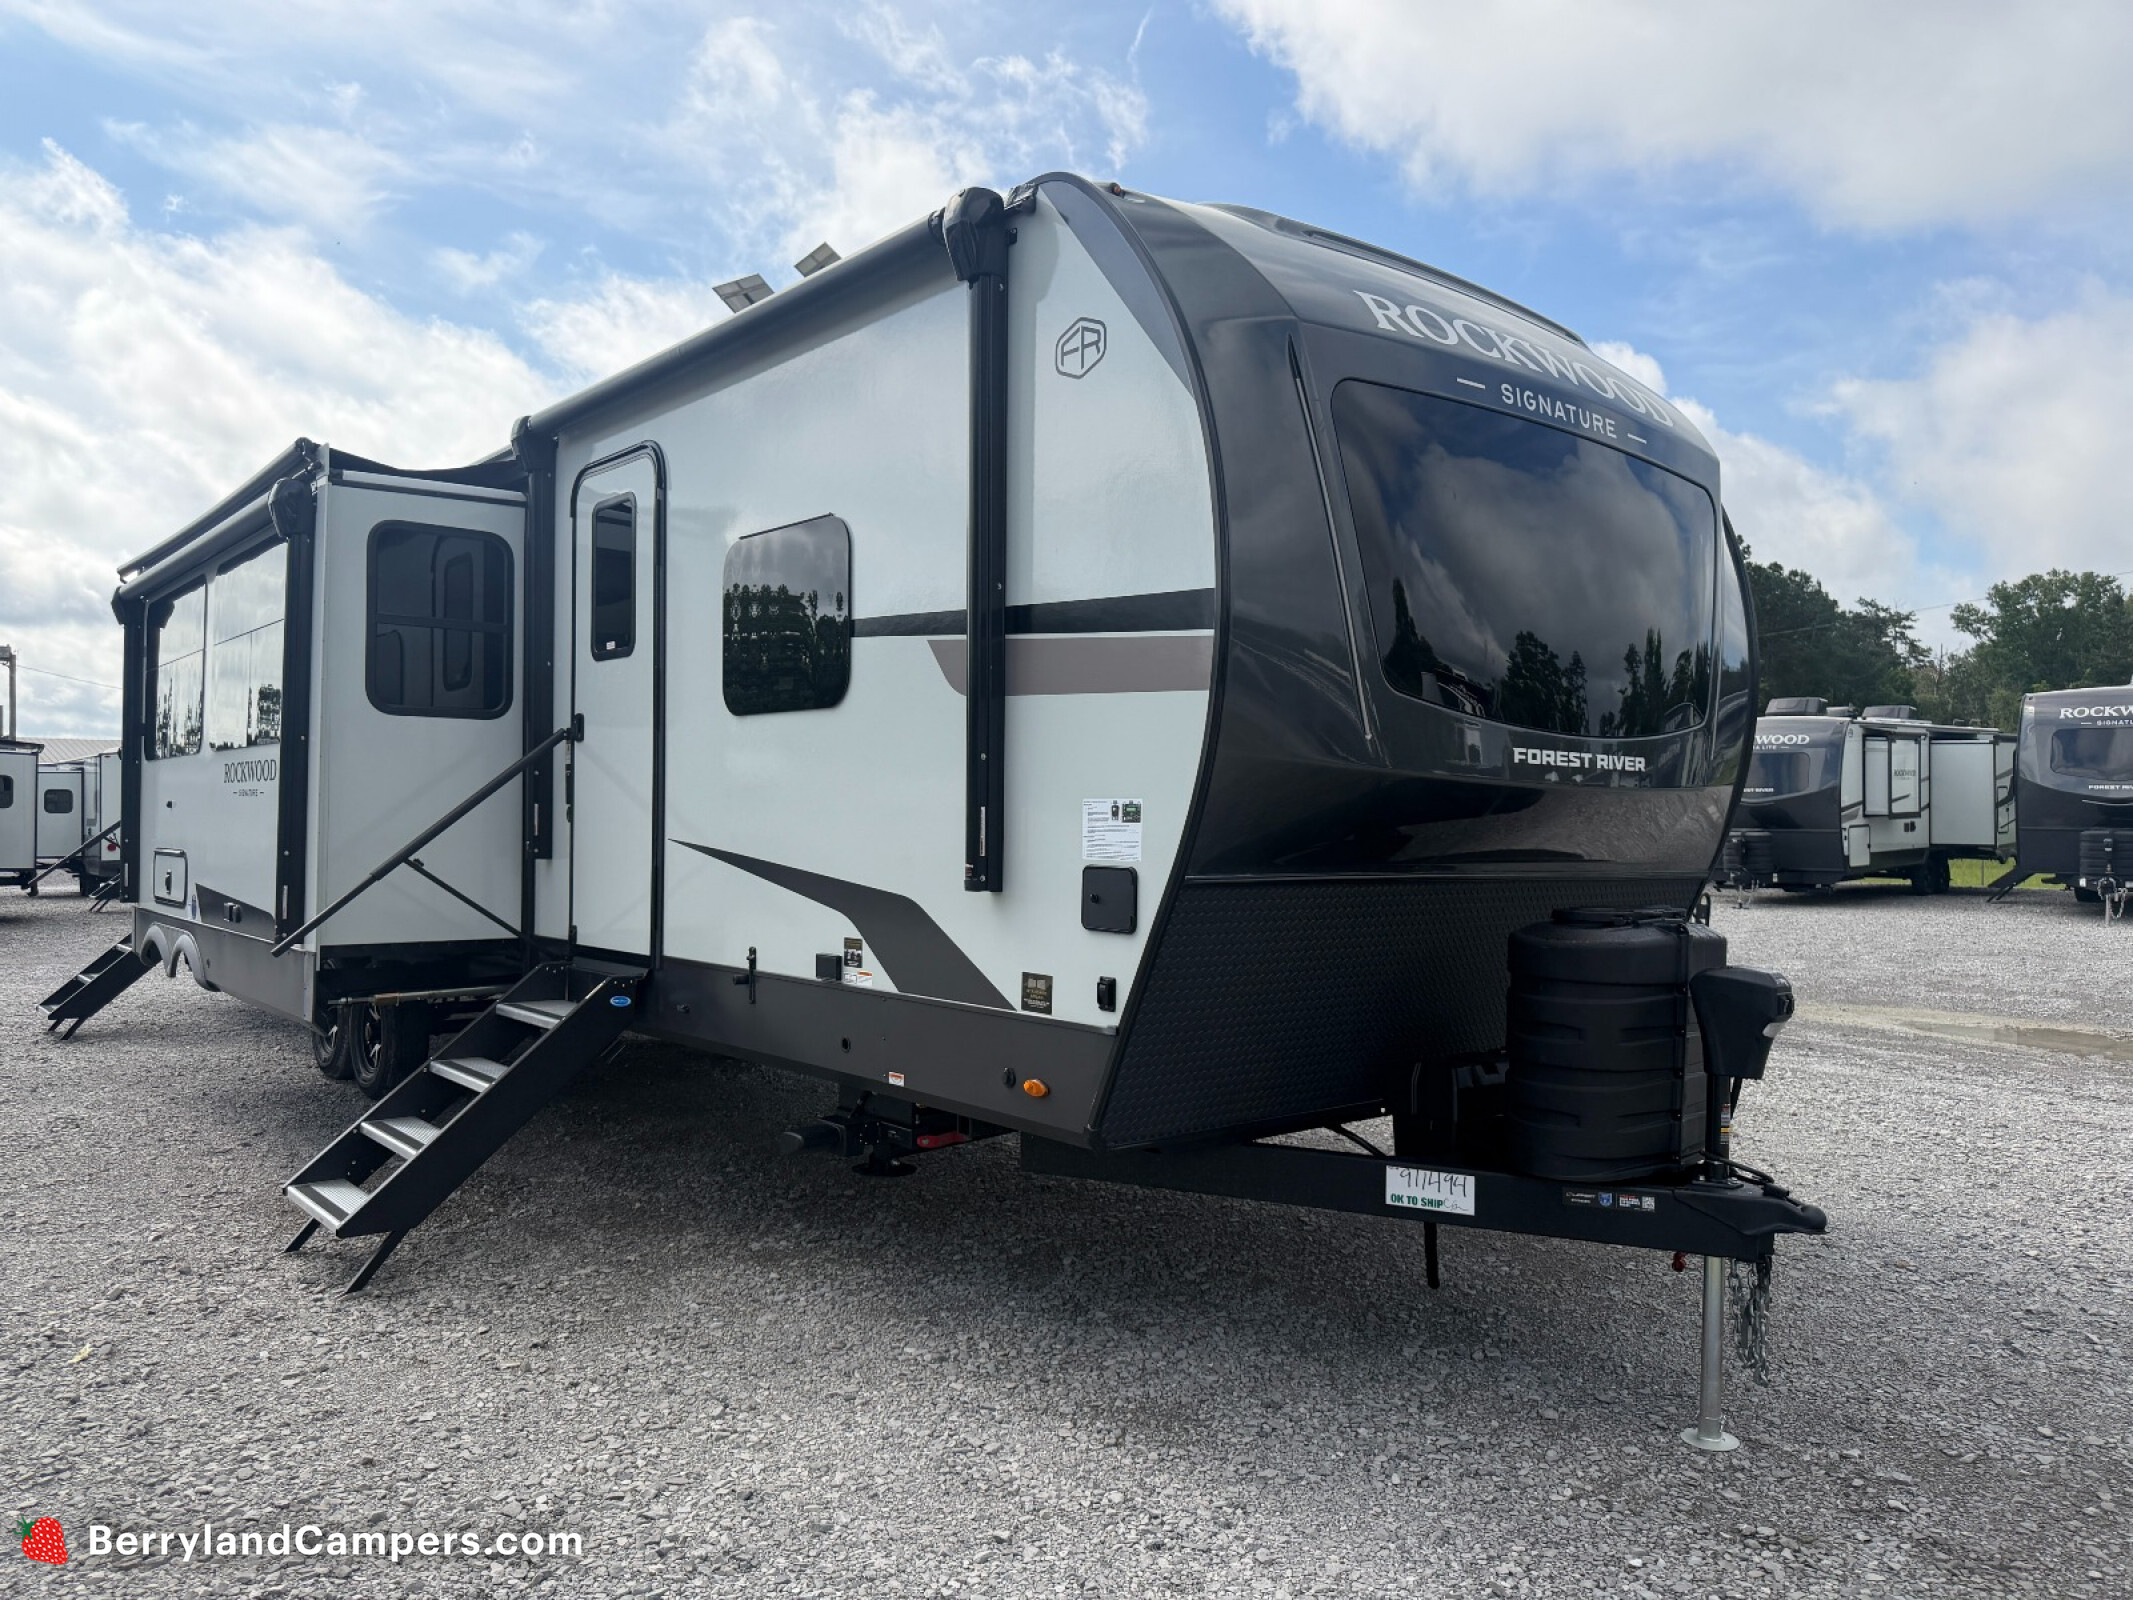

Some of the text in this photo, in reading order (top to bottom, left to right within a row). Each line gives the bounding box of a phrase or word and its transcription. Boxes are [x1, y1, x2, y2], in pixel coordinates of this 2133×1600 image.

[1353, 290, 1674, 428] ROCKWOOD
[1500, 383, 1617, 439] SIGNATURE
[223, 759, 277, 784] ROCKWOOD
[1513, 747, 1646, 772] FOREST RIVER
[1391, 1193, 1404, 1204] OK
[1406, 1195, 1418, 1206] TO
[1420, 1197, 1444, 1209] SHIP
